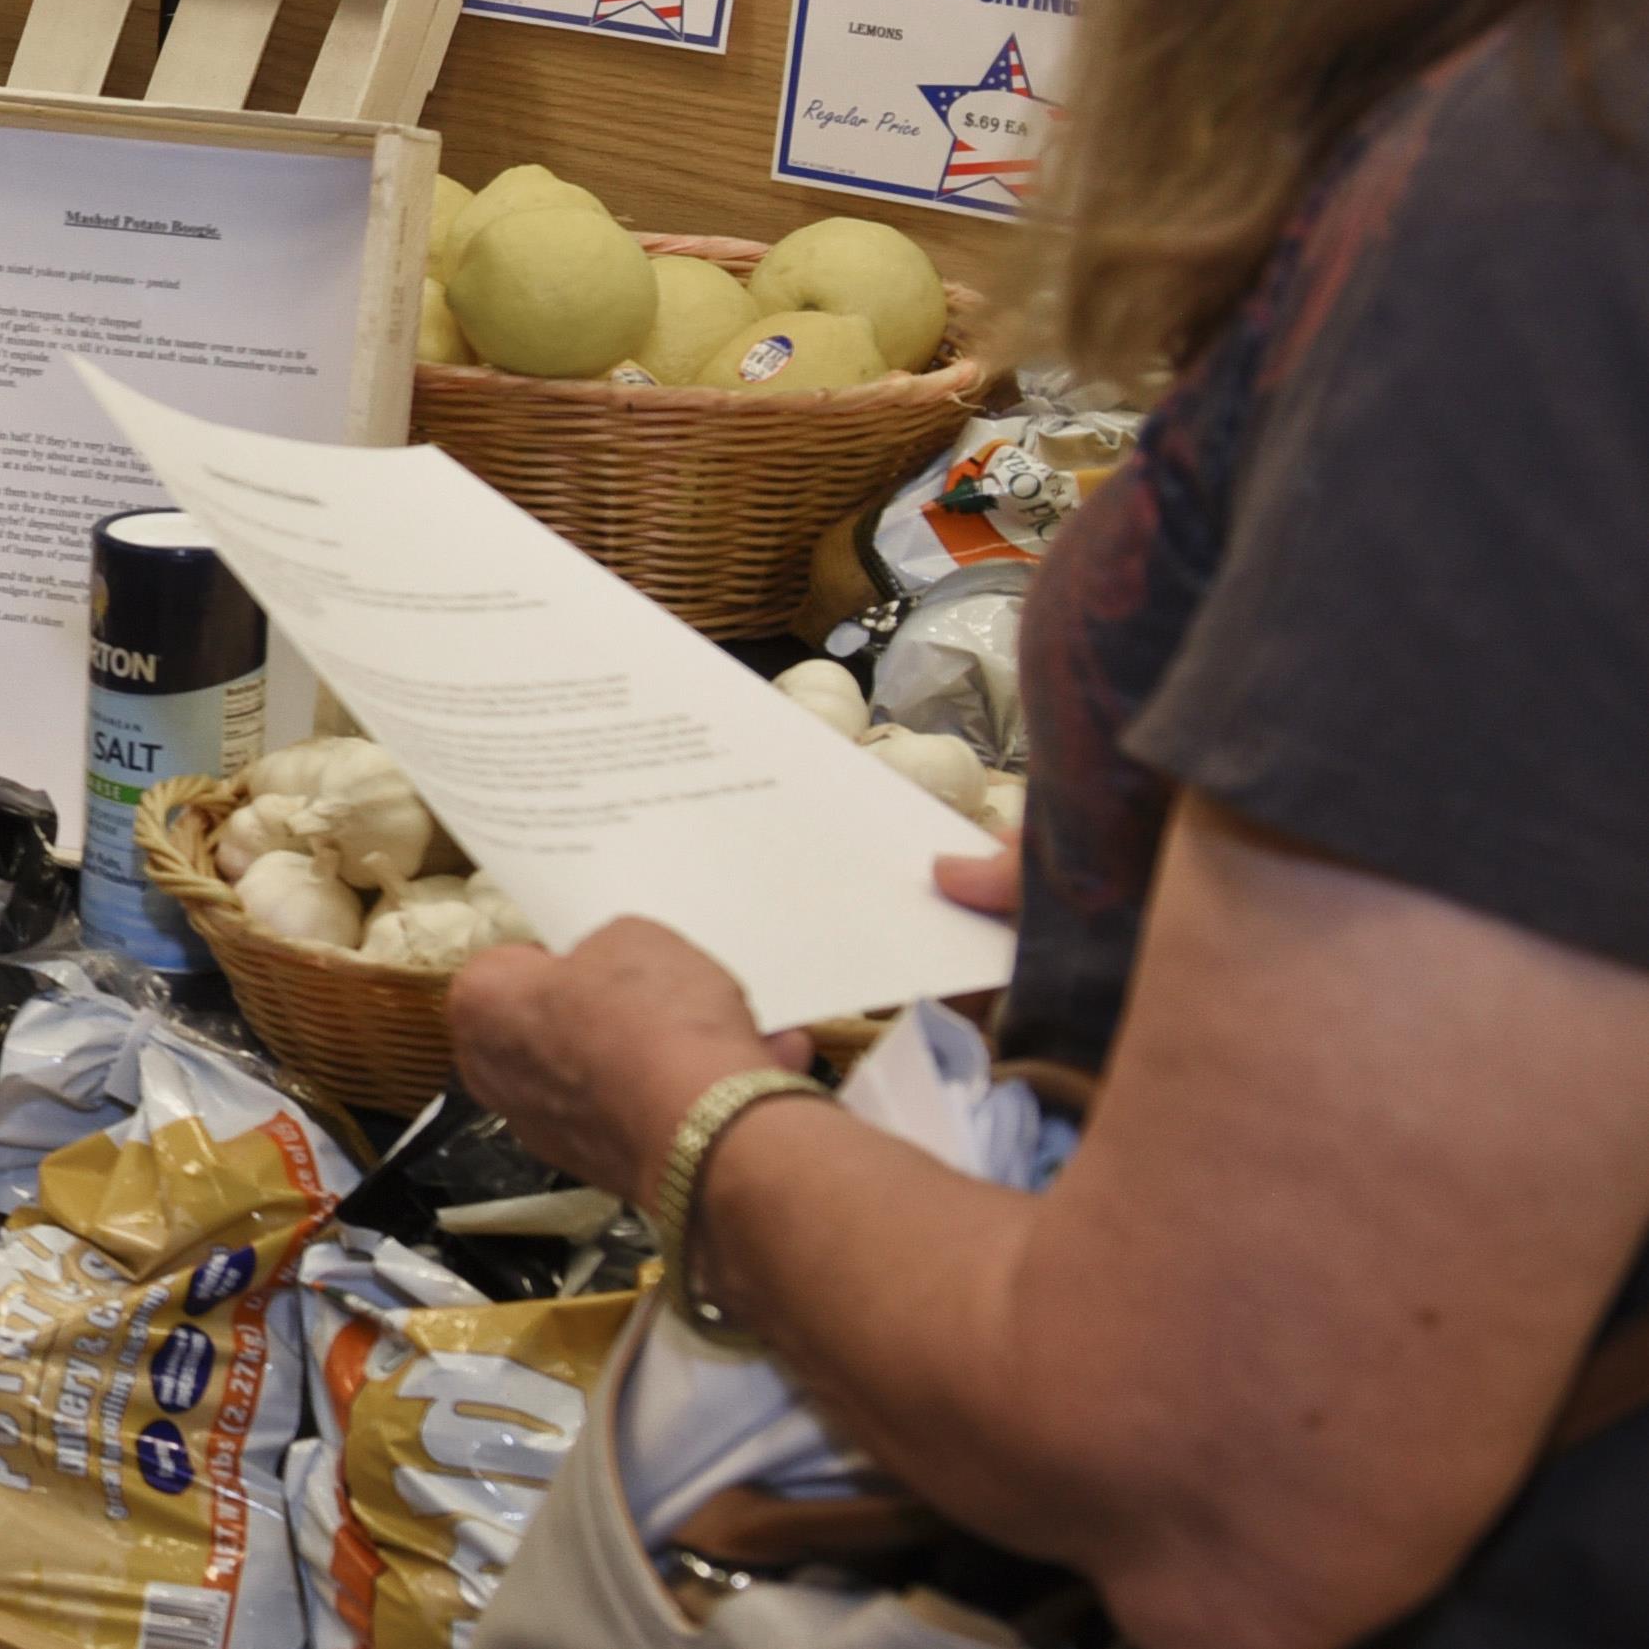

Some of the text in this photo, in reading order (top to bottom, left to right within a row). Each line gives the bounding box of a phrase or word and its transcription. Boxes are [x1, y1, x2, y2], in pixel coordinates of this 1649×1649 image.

[848, 22, 903, 41] LEMONS
[803, 99, 921, 136] Regular Price
[964, 113, 1028, 137] $.69 EA
[94, 731, 162, 772] SALT
